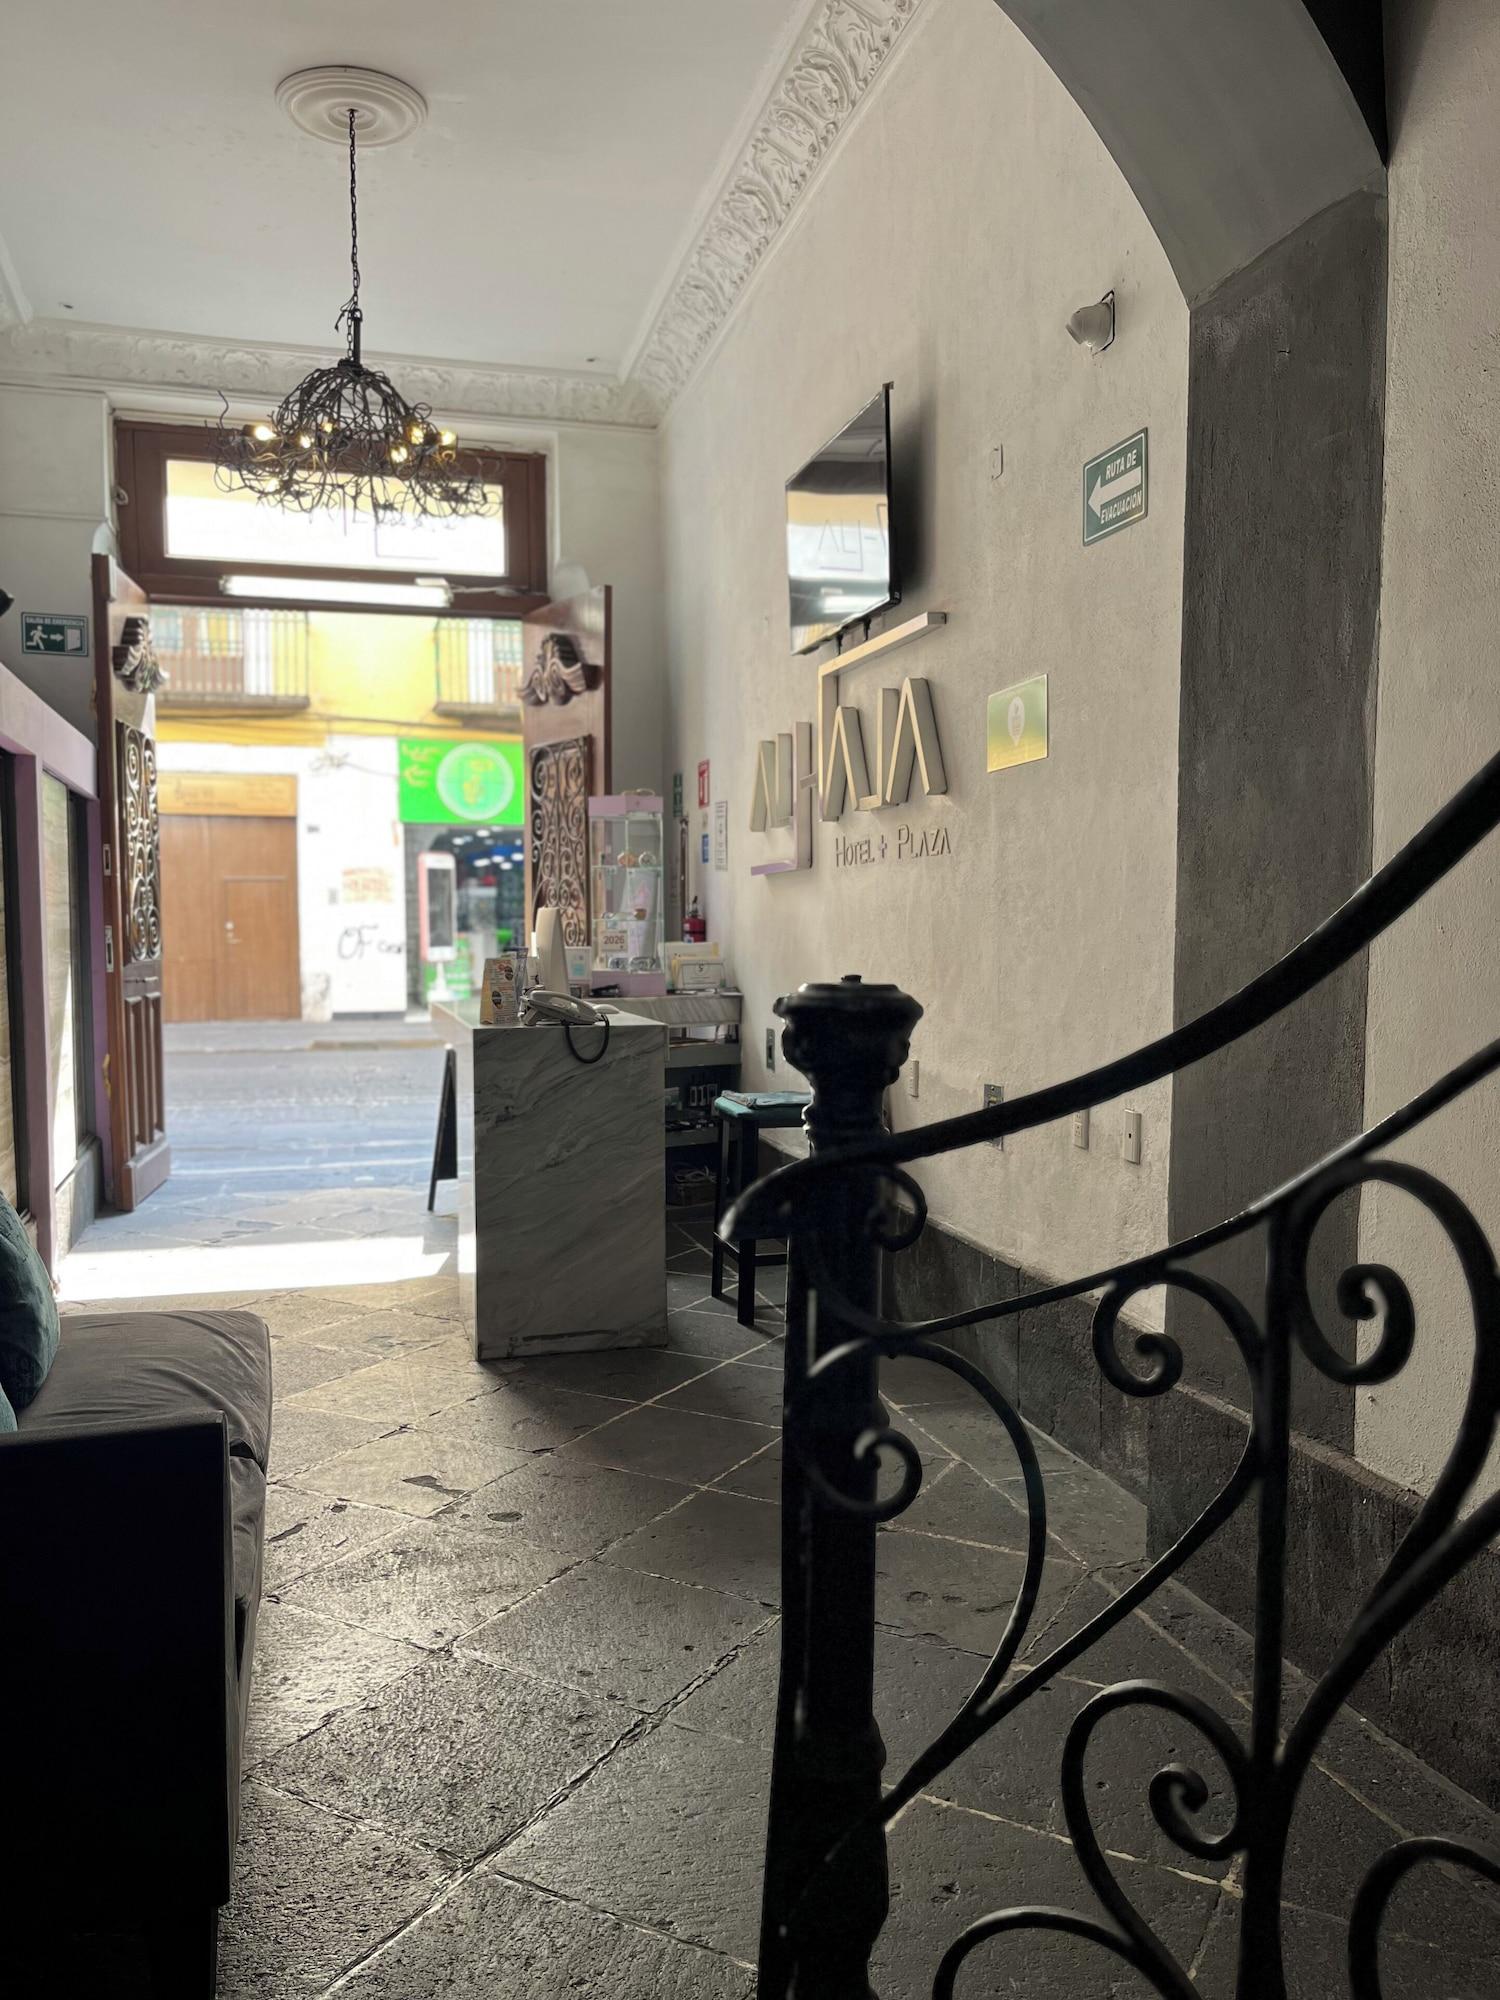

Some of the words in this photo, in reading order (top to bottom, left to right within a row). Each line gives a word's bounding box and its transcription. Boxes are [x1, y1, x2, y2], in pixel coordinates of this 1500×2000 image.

[1105, 457, 1125, 480] RUTA
[1126, 449, 1137, 469] DE
[836, 836, 875, 868] HOTEL
[898, 823, 951, 860] PLAZA
[603, 935, 625, 945] 2026
